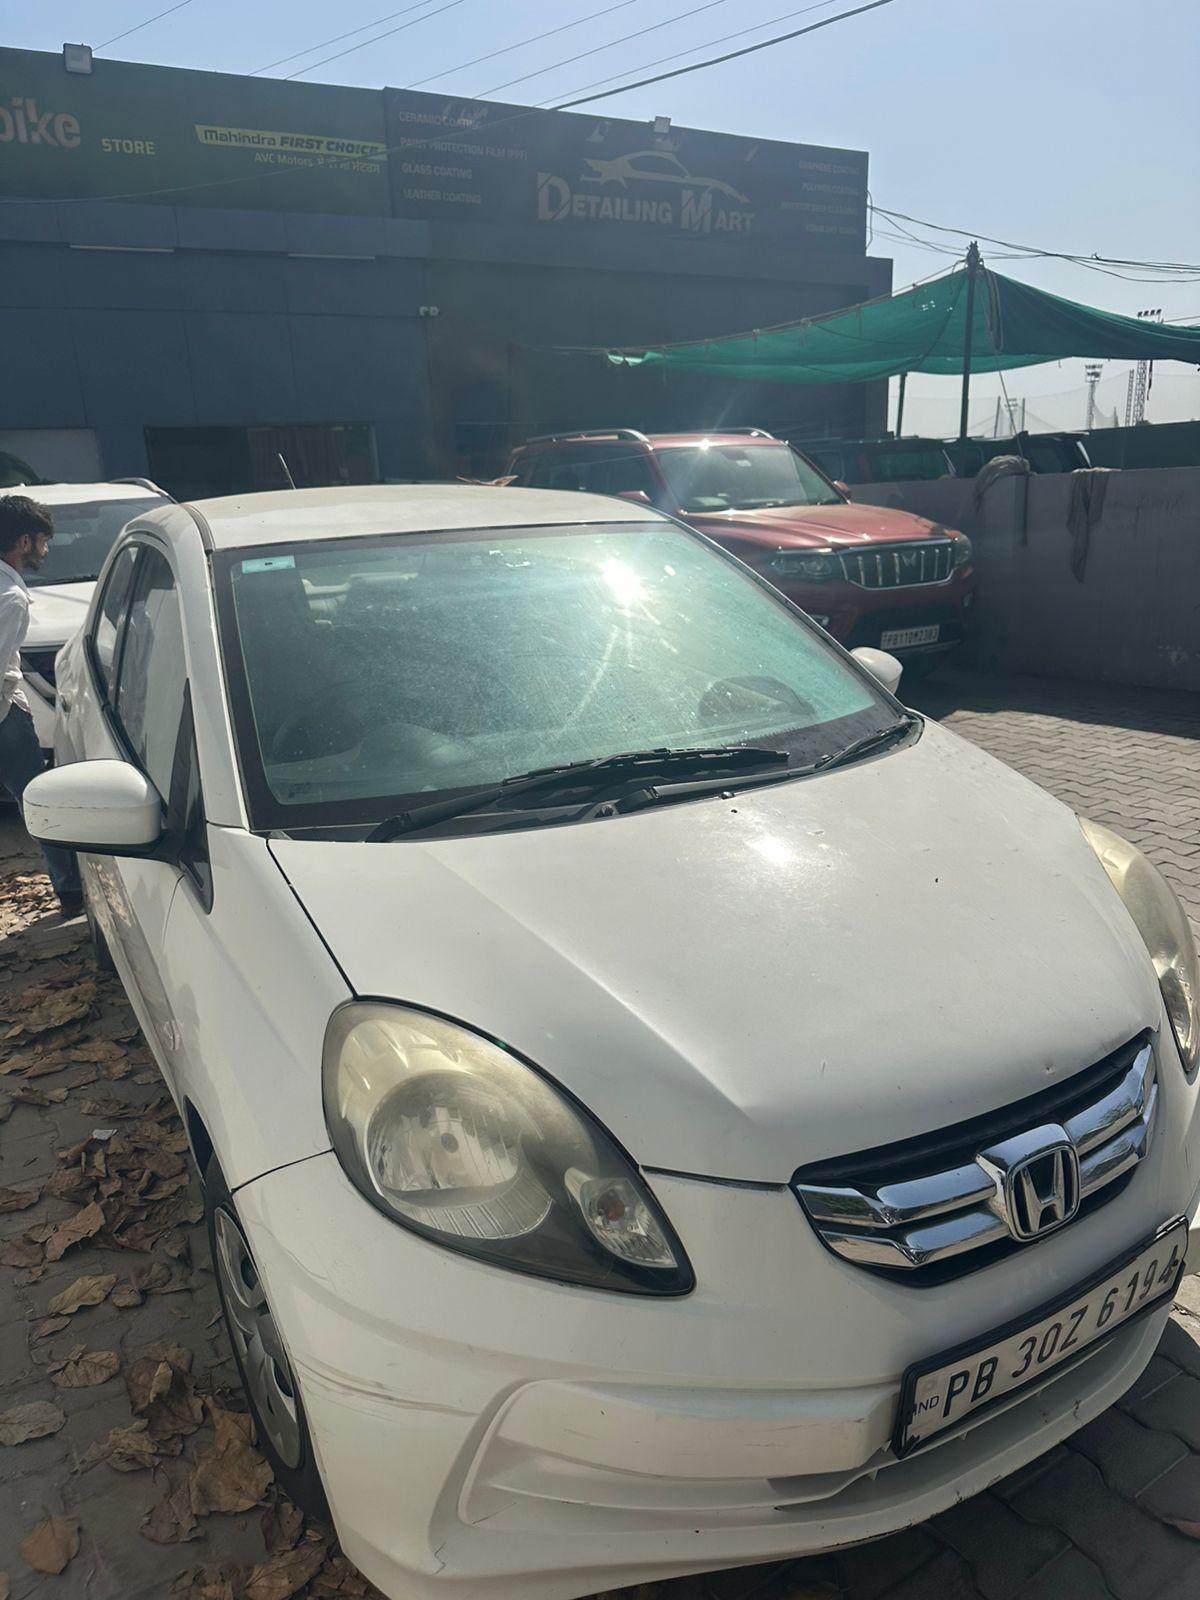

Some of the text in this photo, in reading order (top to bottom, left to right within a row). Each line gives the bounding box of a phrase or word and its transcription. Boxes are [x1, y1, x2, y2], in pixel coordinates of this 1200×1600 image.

[102, 138, 156, 155] STORE
[204, 129, 378, 155] Mahindra FIRST CHOICE
[429, 141, 484, 156] PROTECTION
[485, 148, 505, 159] FILM
[254, 152, 275, 164] AVC
[277, 156, 313, 168] Motors
[401, 163, 473, 180] GLASS COATING
[403, 188, 481, 205] LEATHER COATING
[537, 172, 755, 234] DETAILING MART
[942, 1244, 1180, 1418] PB 30Z 6194
